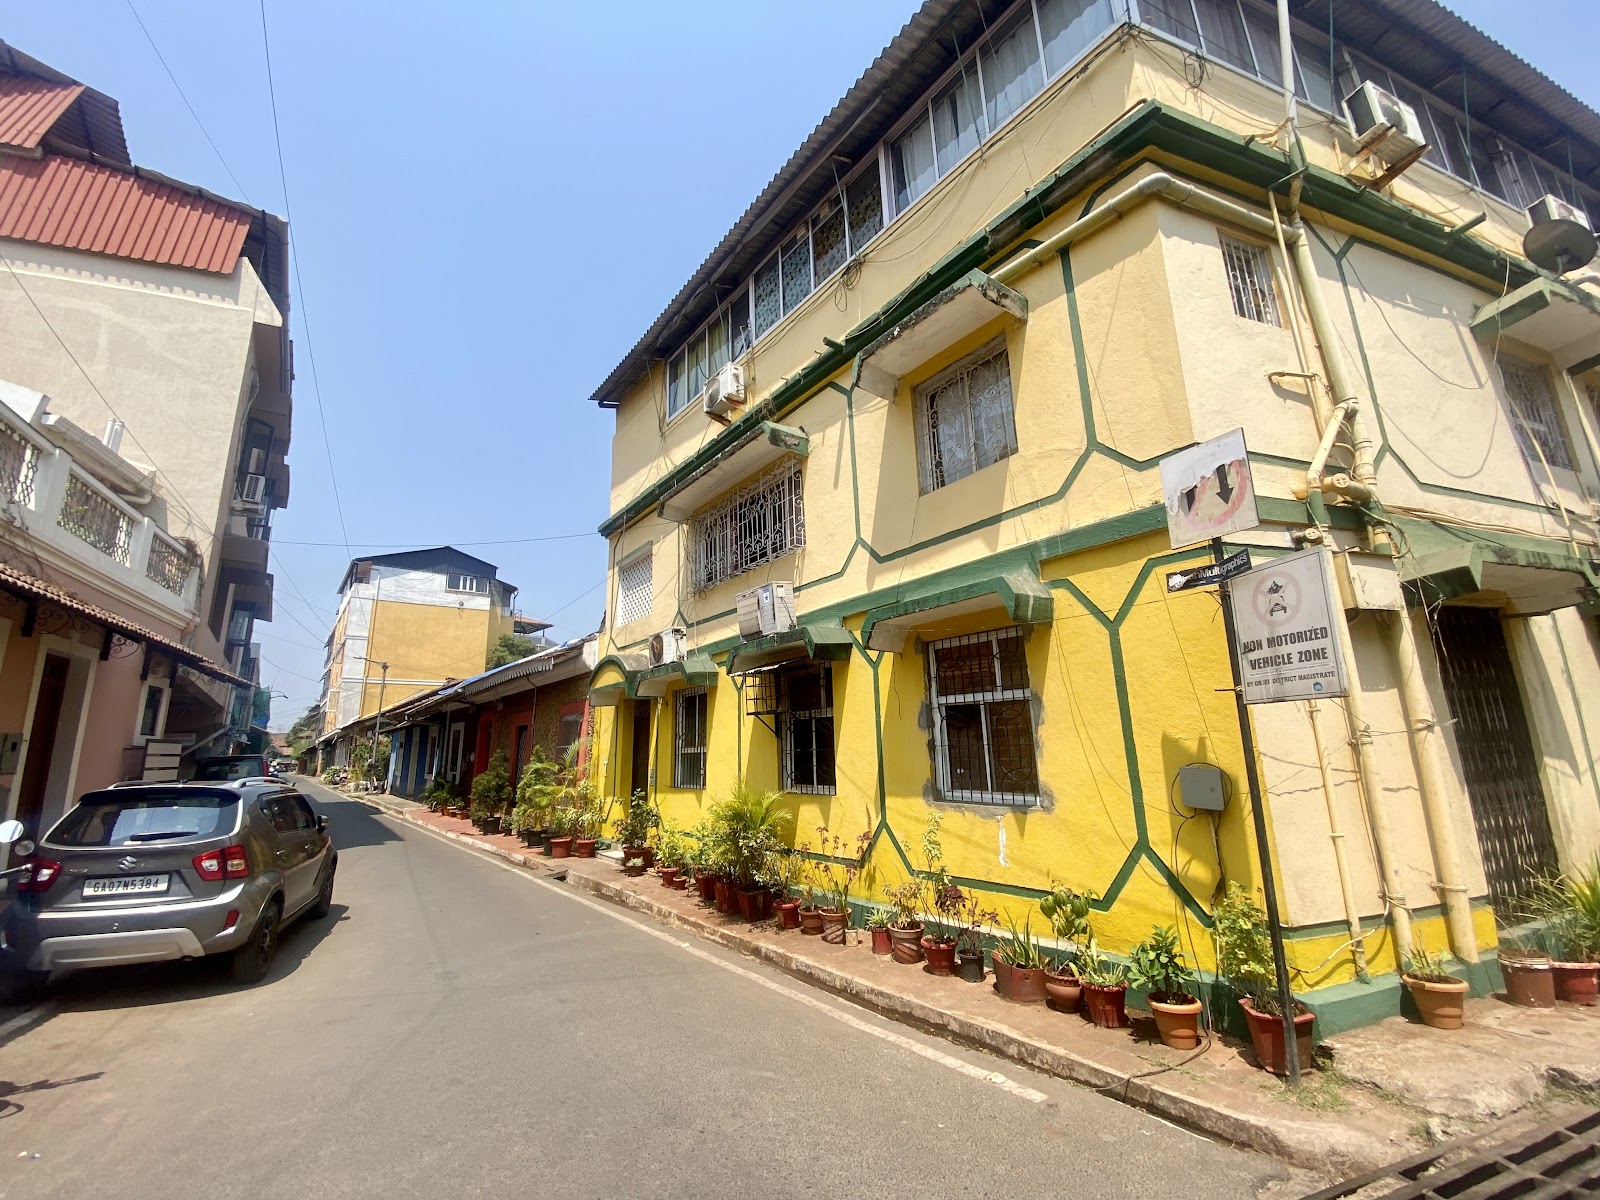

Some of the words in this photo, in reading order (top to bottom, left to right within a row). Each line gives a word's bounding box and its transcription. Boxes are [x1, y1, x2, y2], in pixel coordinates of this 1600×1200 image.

[1243, 639, 1263, 651] NON
[1266, 627, 1328, 648] MOTORIZED
[1249, 652, 1294, 671] VEHICLE
[1297, 647, 1328, 663] ZONE
[1272, 675, 1297, 684] DISTRICT
[1297, 670, 1336, 681] MAGISTRATE
